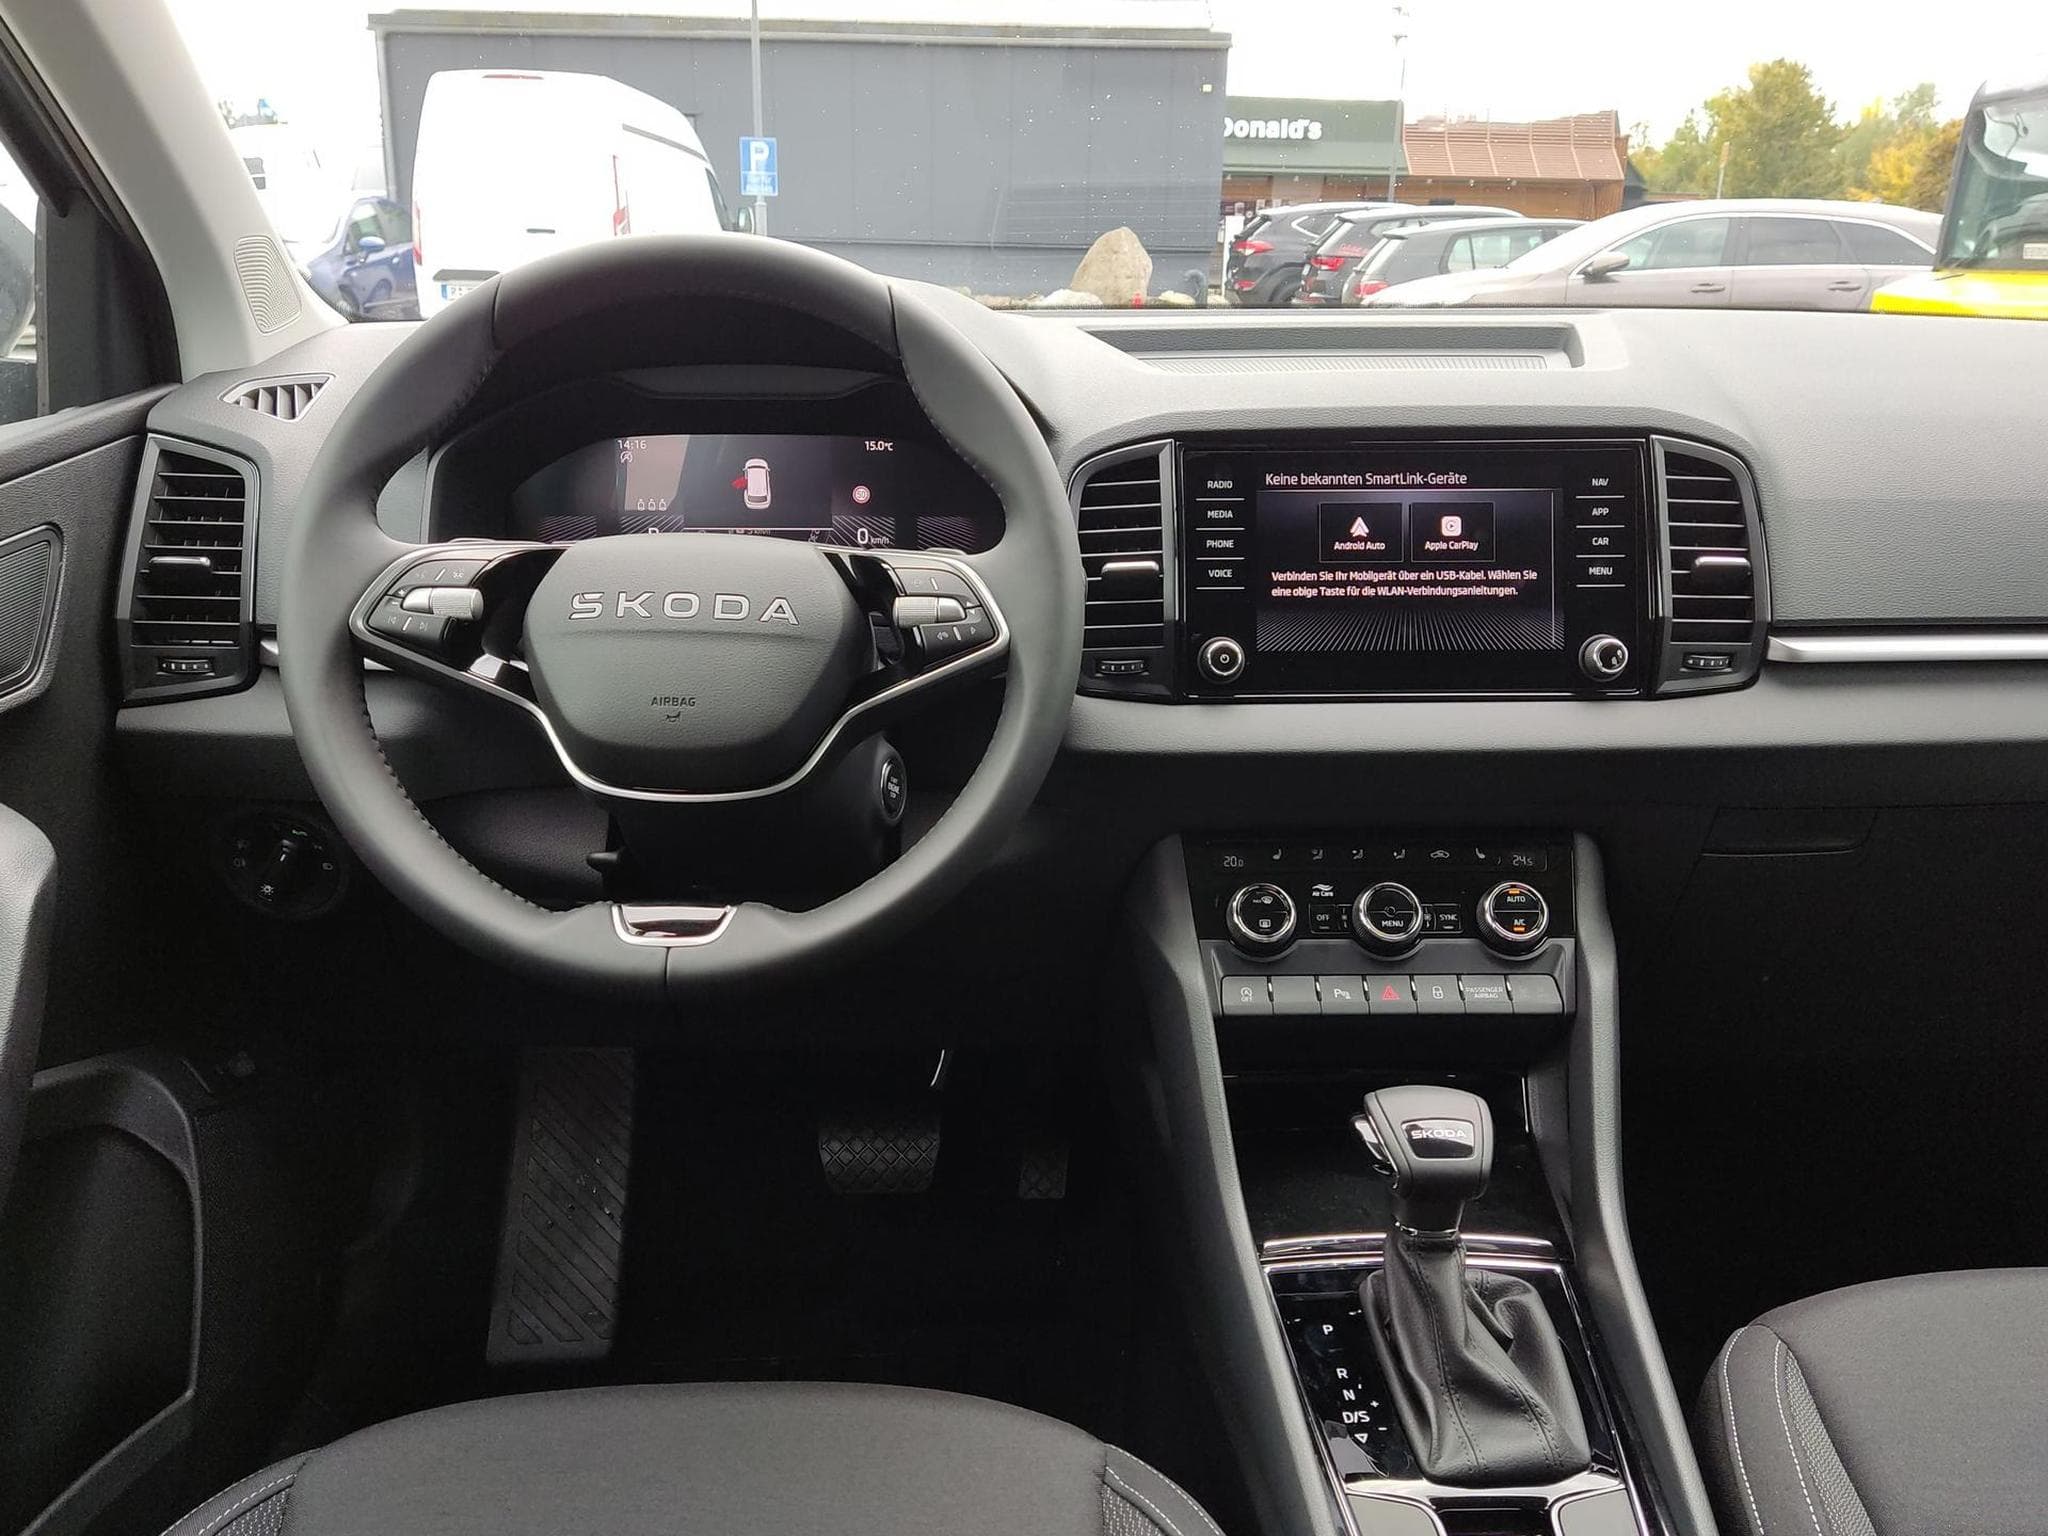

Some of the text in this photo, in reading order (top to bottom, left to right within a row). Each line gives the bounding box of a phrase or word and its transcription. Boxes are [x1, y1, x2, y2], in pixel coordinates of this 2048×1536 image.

[749, 140, 770, 174] P
[617, 439, 647, 449] 14:16
[1265, 471, 1468, 486] Keine bekannten SmartLink-Geräte
[1591, 478, 1609, 487] NAV
[1207, 480, 1234, 489] RADIO
[1207, 510, 1234, 519] MEDIA
[1591, 507, 1610, 516] APP
[857, 527, 869, 545] 0
[1206, 539, 1235, 549] PHONE
[1333, 540, 1386, 550] Android Auto
[1424, 540, 1479, 552] Apple CarPlay
[1592, 537, 1609, 546] CAR
[1207, 569, 1233, 578] VOICE
[1588, 566, 1614, 576] MENU
[1271, 570, 1538, 583] Verbinden Sie Ihr Mobilgerät über ein USB-Kabel. Wählen Sie
[1271, 585, 1519, 599] eine obige Taste für die WLAN-Verbindungsanleitungen.
[650, 696, 697, 708] AIRBAG
[1506, 895, 1526, 903] AUTO
[1381, 919, 1404, 928] MENU
[1321, 1323, 1334, 1336] P
[1335, 1367, 1349, 1380] R
[1342, 1388, 1356, 1401] N
[1341, 1410, 1371, 1424] D/S
